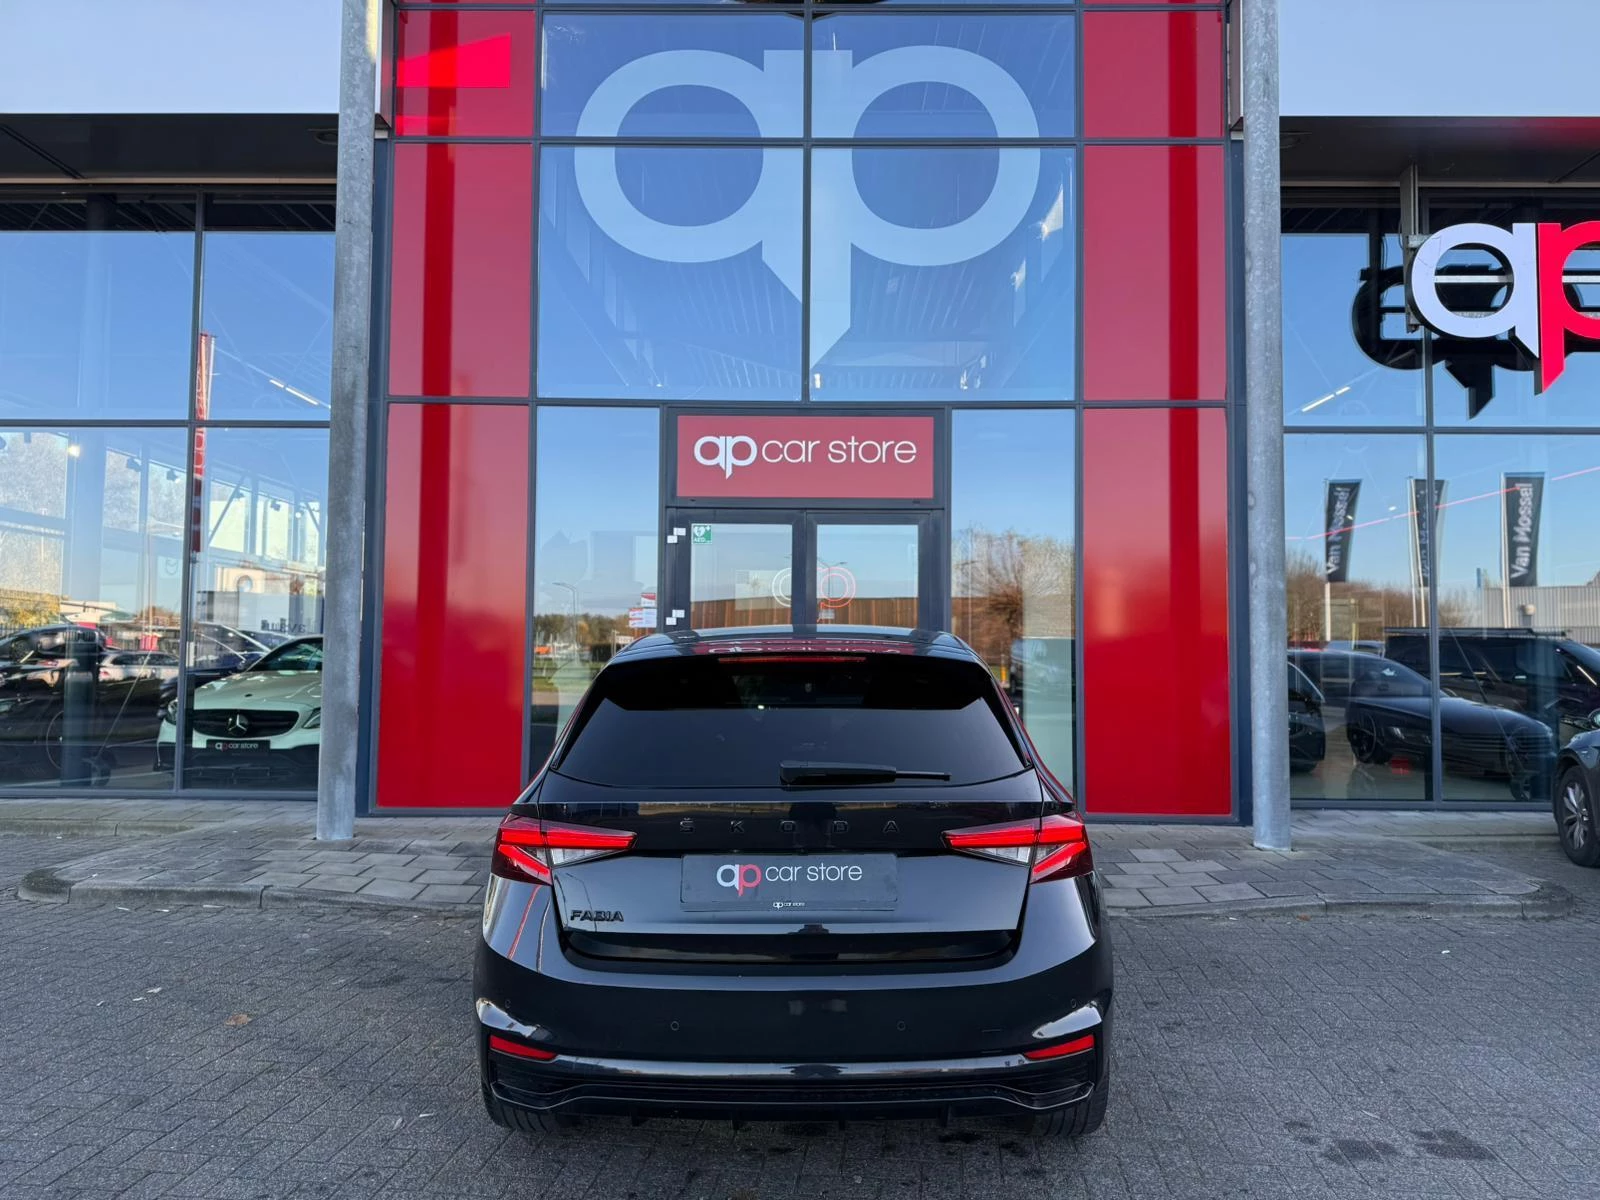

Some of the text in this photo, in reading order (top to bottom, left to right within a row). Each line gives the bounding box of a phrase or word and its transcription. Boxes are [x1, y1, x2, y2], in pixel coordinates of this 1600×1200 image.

[574, 45, 1040, 368] ap
[694, 435, 917, 479] ap car store
[1510, 483, 1533, 578] Van Mossel
[1326, 545, 1341, 574] Van
[680, 818, 898, 833] ŠKODA
[716, 863, 863, 897] ap car store
[570, 909, 625, 922] FABIA
